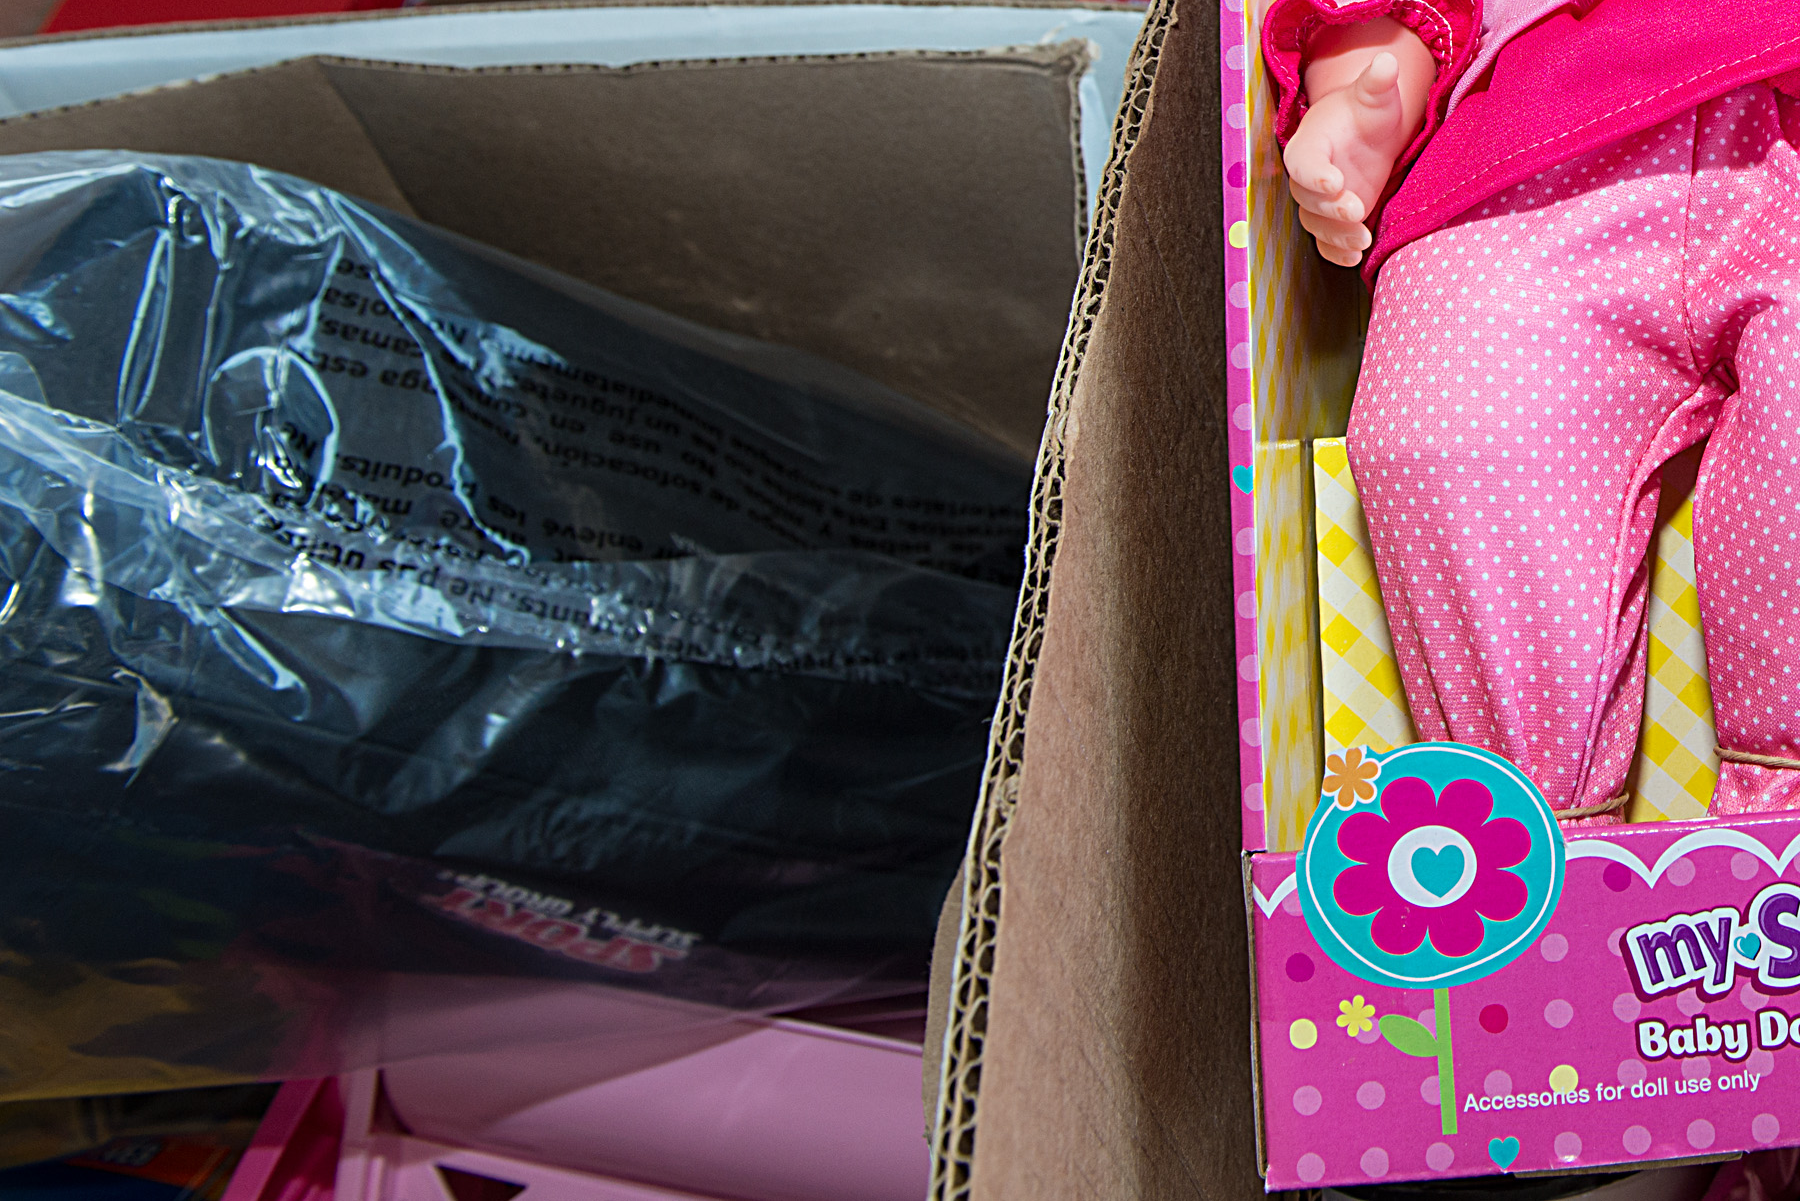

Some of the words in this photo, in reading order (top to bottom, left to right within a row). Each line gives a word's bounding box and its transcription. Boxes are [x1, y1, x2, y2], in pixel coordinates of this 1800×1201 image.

[417, 888, 690, 974] SPORT
[1634, 914, 1734, 988] my
[1637, 1017, 1749, 1060] Baby
[1463, 1085, 1591, 1113] Accessories
[1595, 1082, 1625, 1103] for
[1630, 1076, 1669, 1099] doll
[1674, 1075, 1712, 1095] use
[1717, 1069, 1762, 1092] only
